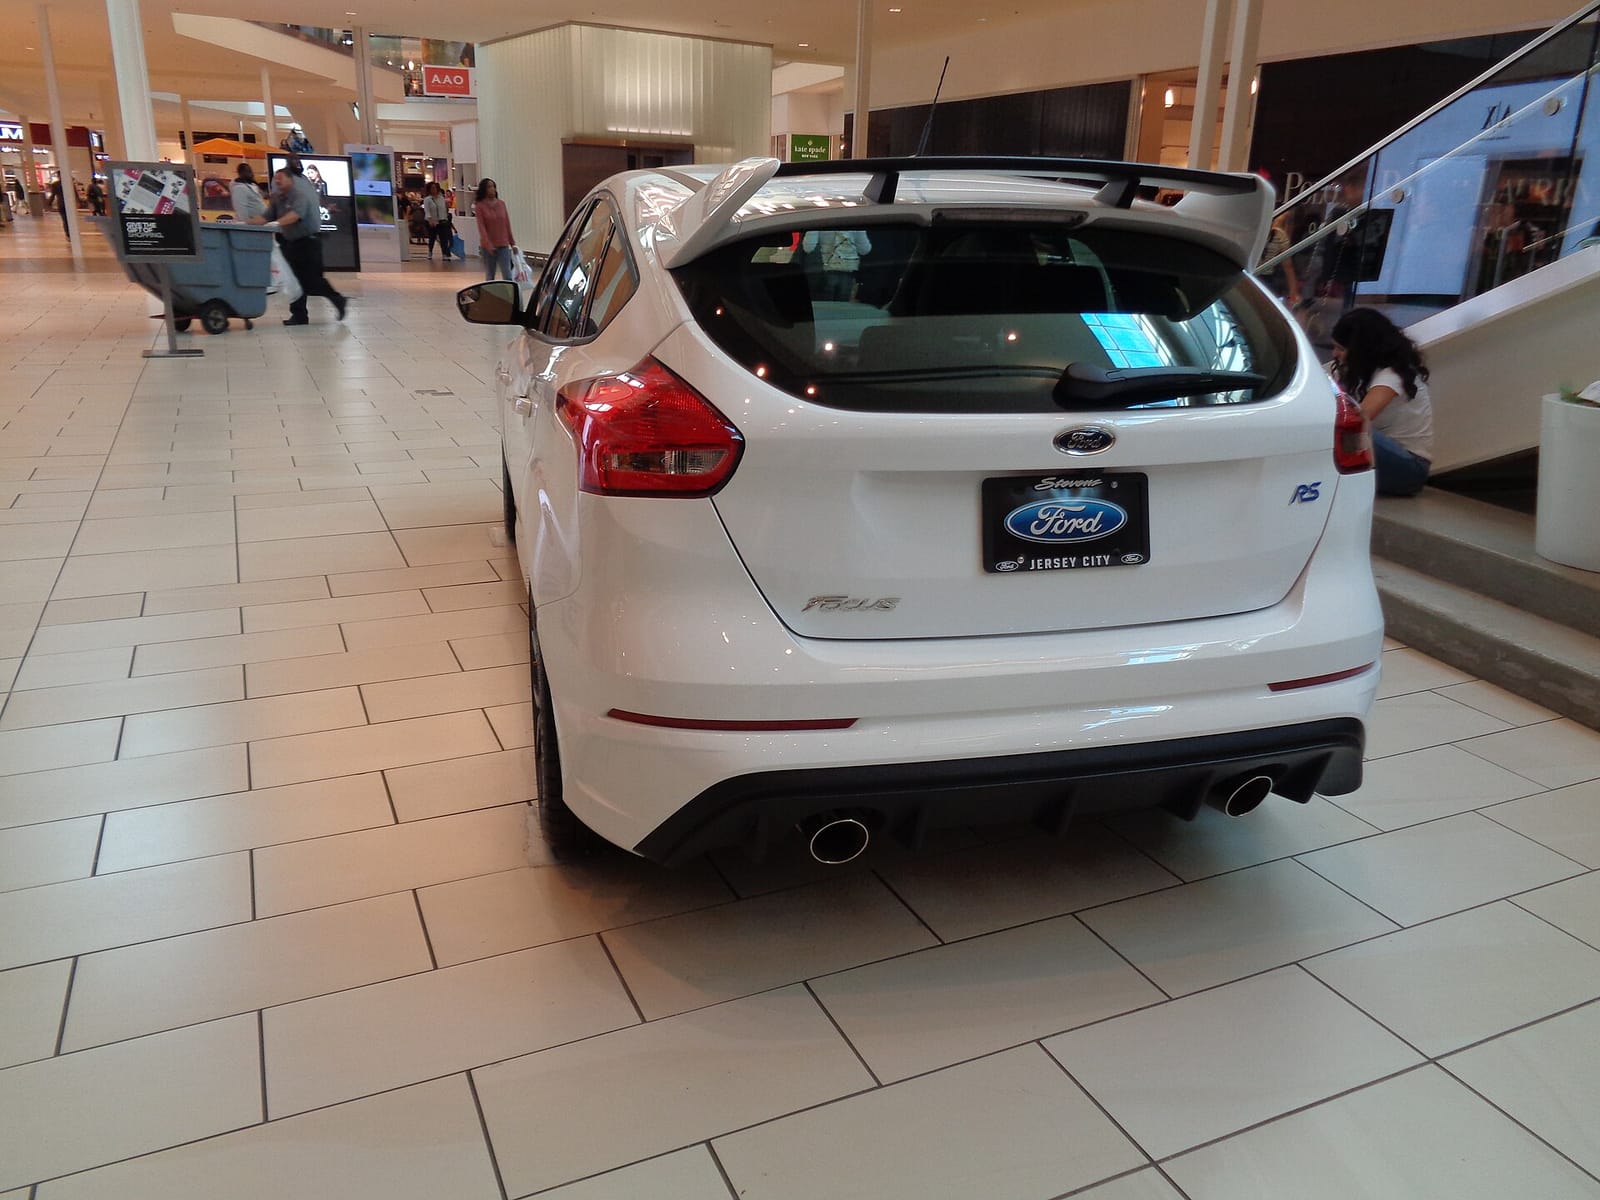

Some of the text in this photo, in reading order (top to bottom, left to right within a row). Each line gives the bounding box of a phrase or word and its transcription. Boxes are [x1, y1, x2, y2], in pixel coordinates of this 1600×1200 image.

[431, 74, 464, 85] AAO
[808, 146, 826, 154] spade
[1067, 431, 1103, 449] Ford
[1034, 477, 1103, 491] Stevens
[1288, 481, 1322, 506] RS
[1030, 505, 1103, 535] Ford
[1030, 555, 1110, 570] JERSEY CITY
